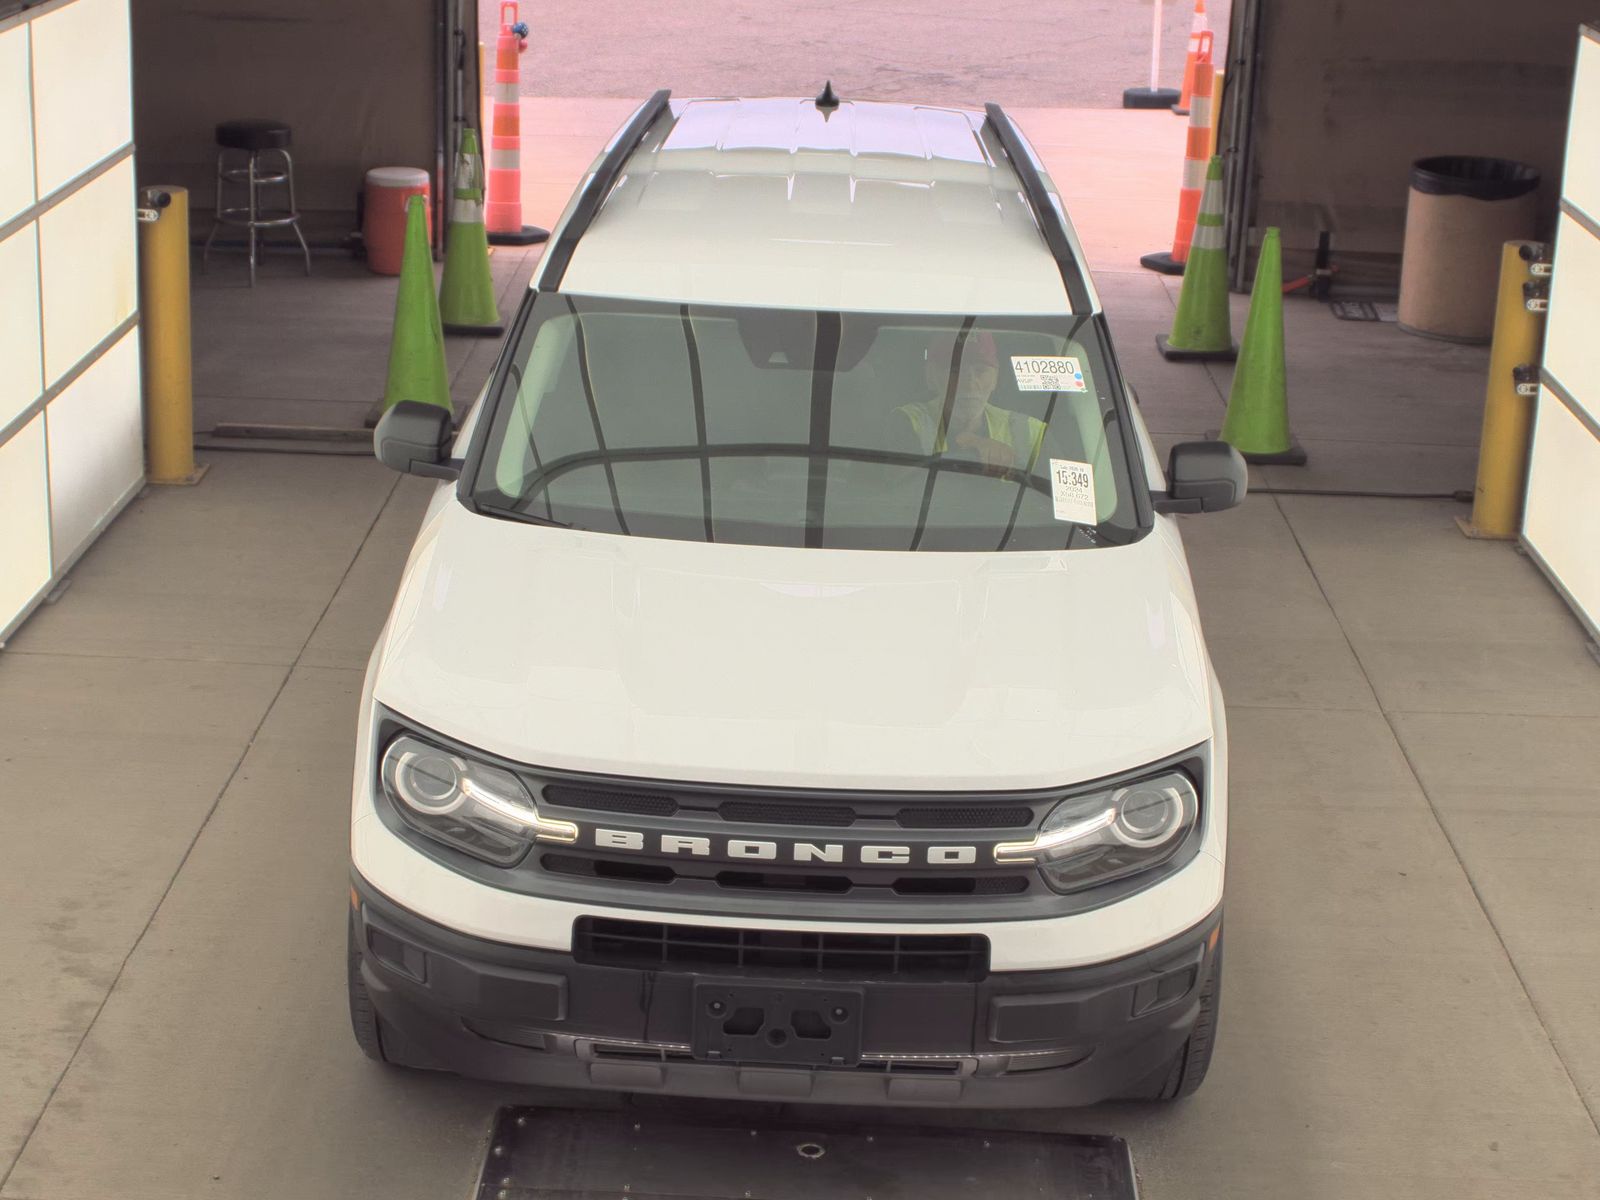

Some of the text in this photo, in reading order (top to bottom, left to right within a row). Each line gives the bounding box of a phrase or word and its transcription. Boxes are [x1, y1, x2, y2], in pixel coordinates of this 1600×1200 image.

[1015, 360, 1075, 375] 4102880
[1056, 469, 1089, 489] 15:349
[595, 828, 977, 864] BRONCO
